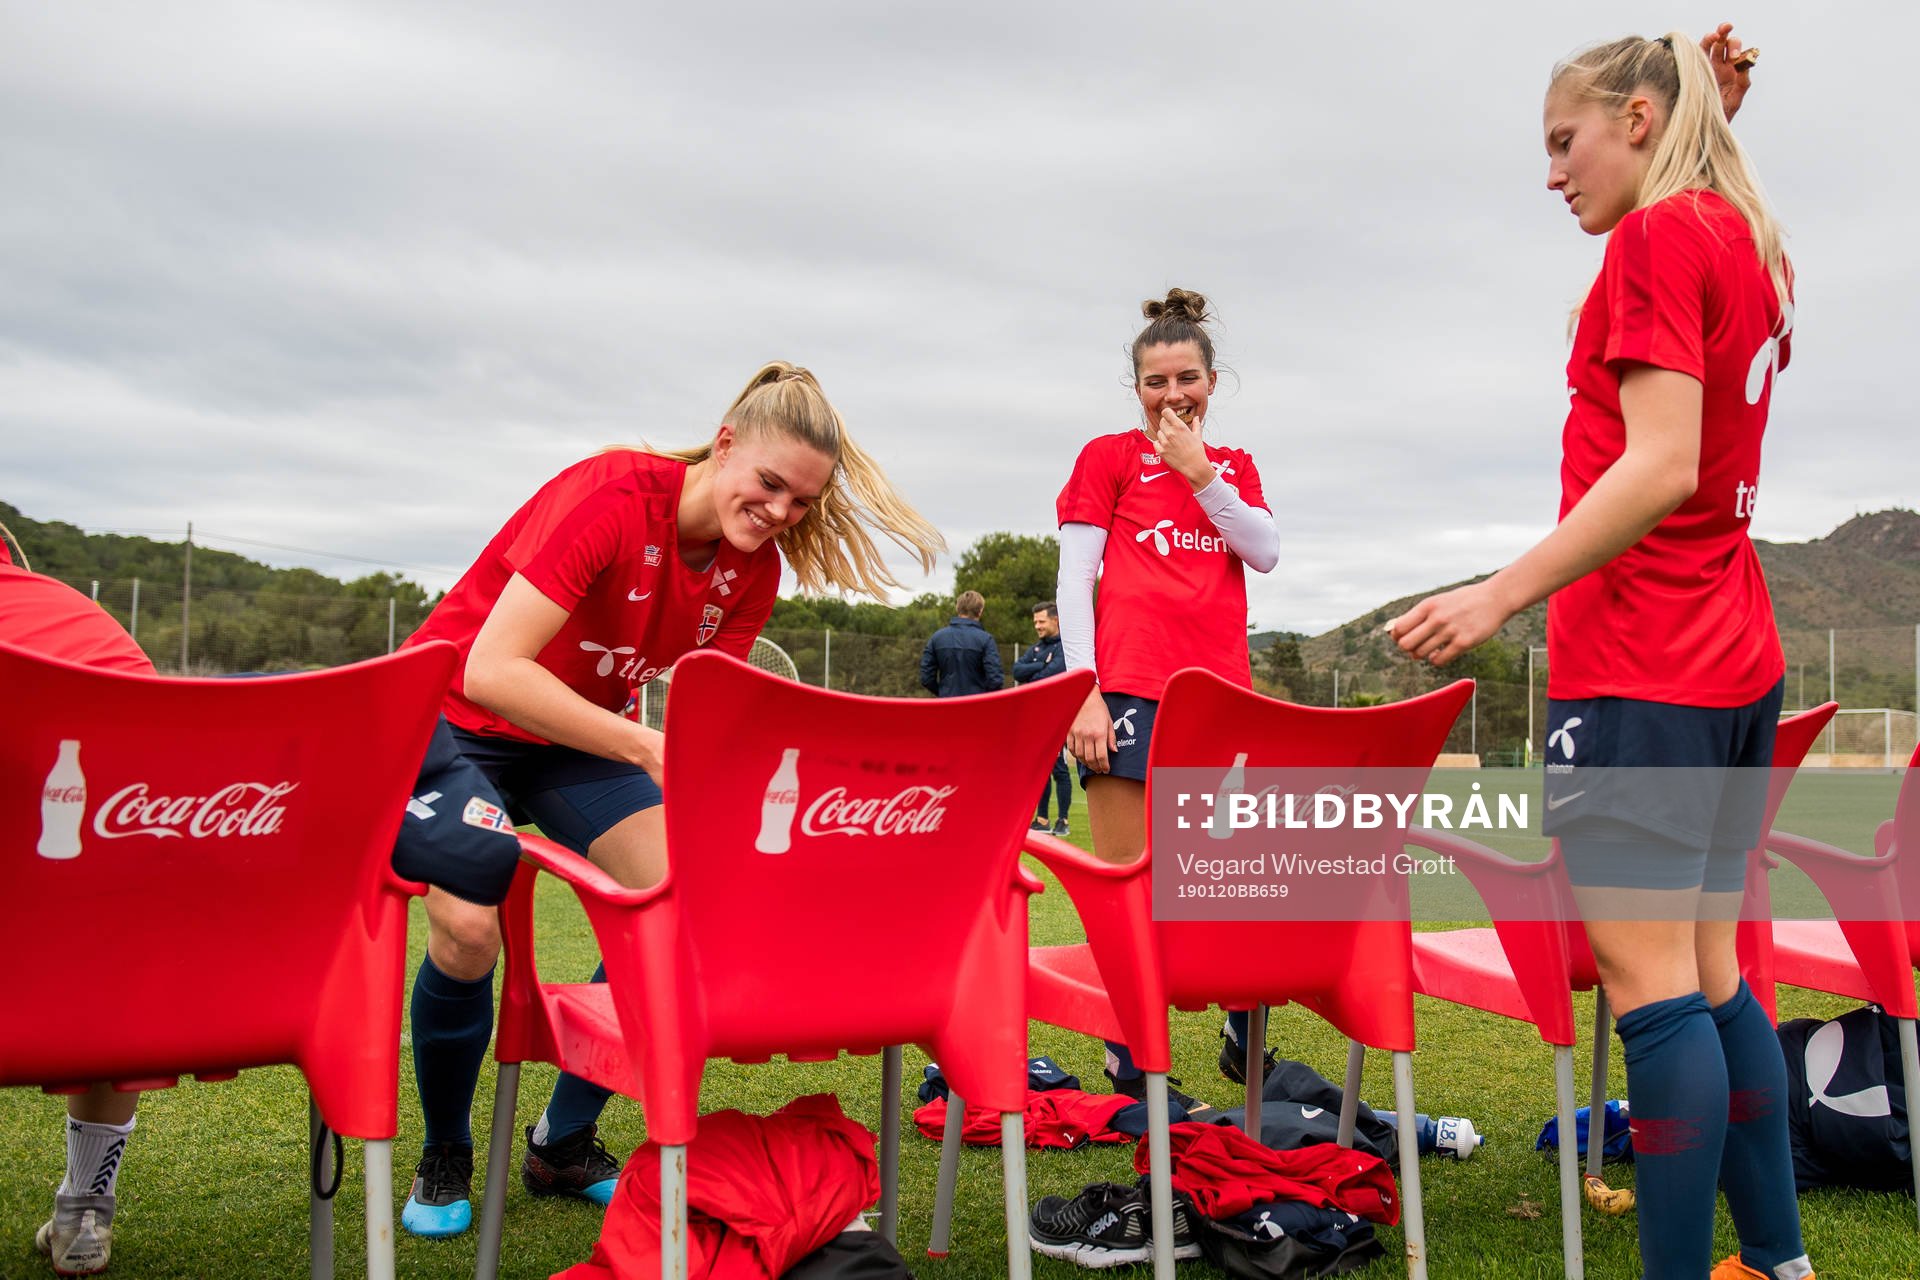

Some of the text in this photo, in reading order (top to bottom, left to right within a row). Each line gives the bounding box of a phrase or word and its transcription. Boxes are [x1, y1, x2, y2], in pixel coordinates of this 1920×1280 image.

[1171, 527, 1231, 555] telen
[93, 781, 300, 838] Coca-Cola
[801, 785, 959, 836] Coca-Cola
[1086, 1210, 1120, 1239] HOKA
